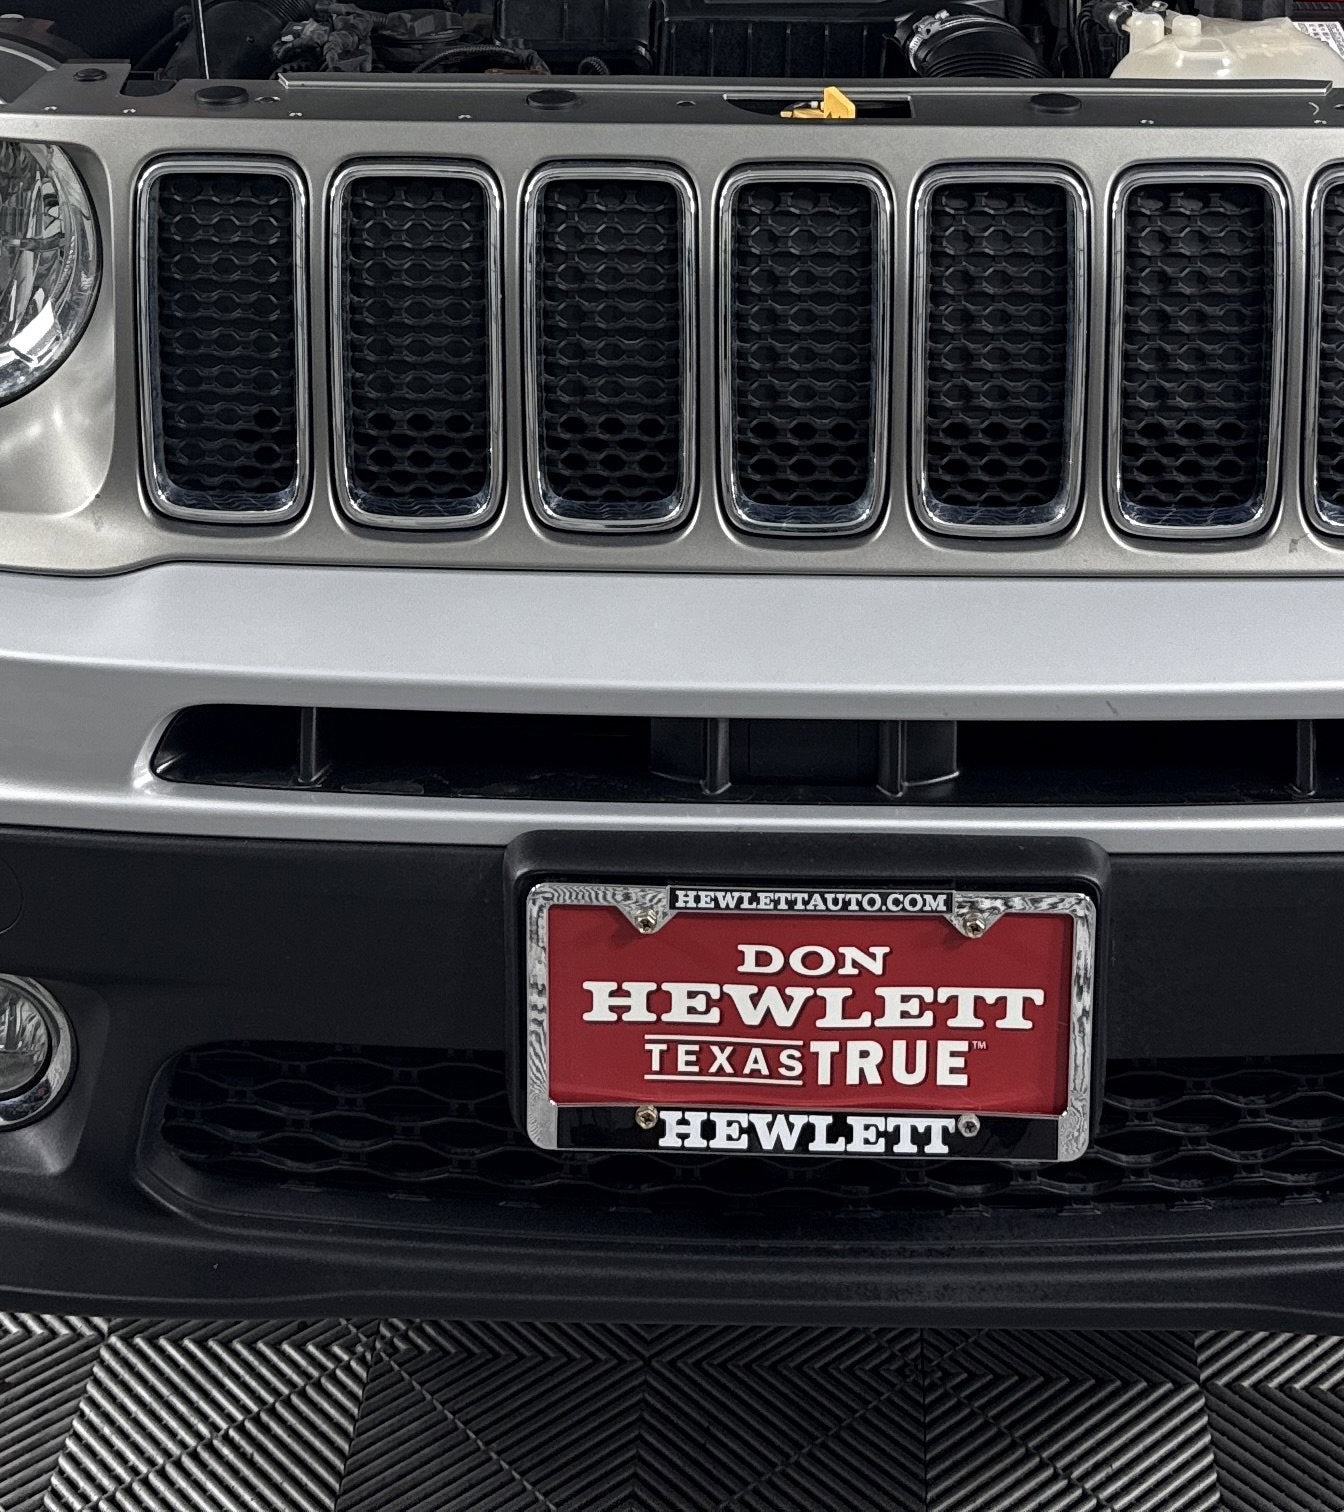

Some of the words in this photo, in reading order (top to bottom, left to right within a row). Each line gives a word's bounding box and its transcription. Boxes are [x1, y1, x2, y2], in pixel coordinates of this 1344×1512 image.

[674, 889, 948, 913] HEWLETTAUTO.COM
[736, 943, 892, 977] DON
[581, 980, 1046, 1031] HEWLETT
[659, 1110, 956, 1155] HEWLETT
